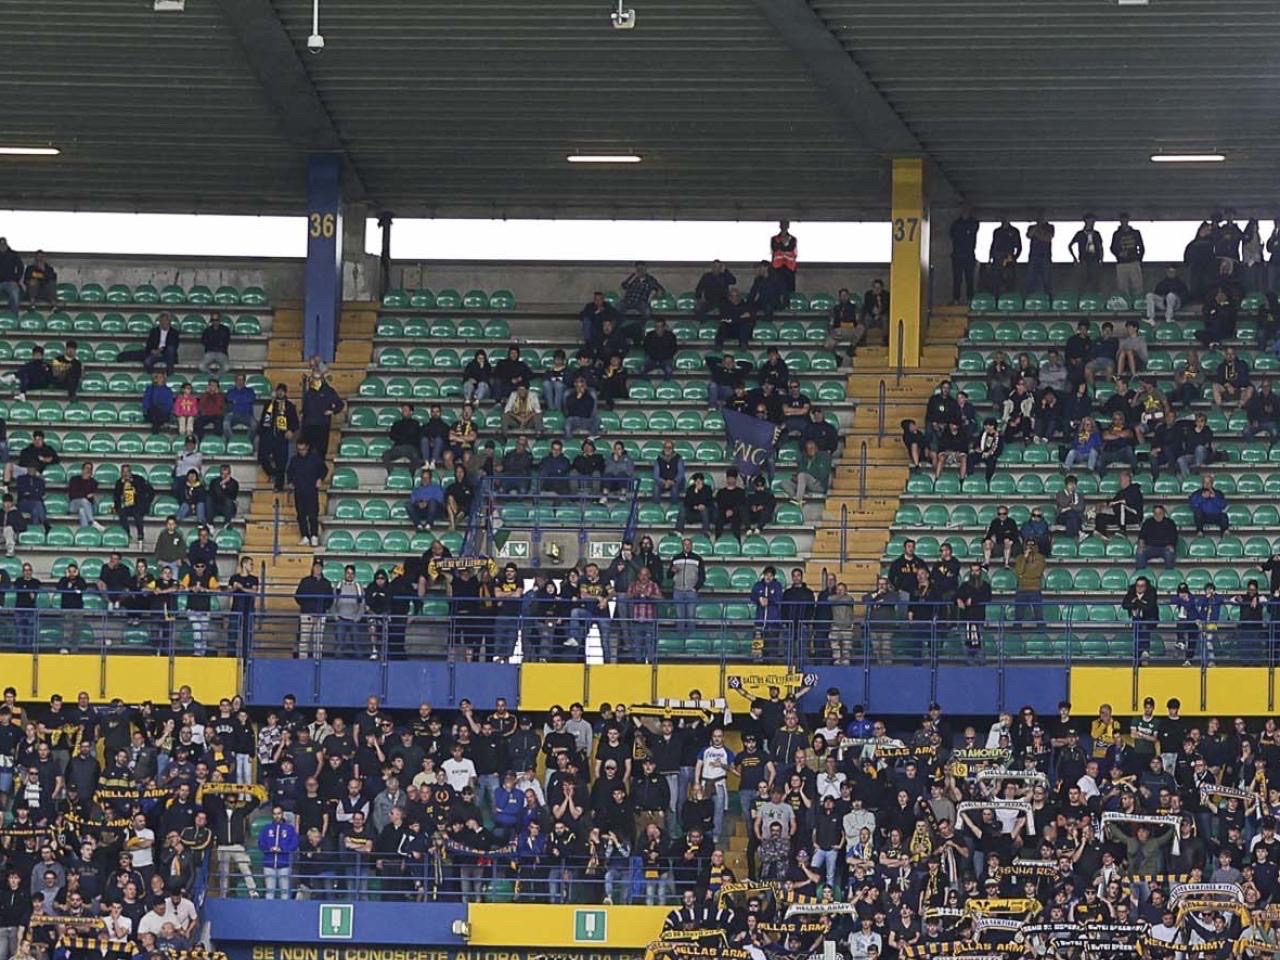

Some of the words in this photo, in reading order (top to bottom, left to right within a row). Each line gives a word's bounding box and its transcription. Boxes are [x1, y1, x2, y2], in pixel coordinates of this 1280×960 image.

[309, 212, 334, 239] 36
[893, 216, 919, 243] 37
[94, 788, 140, 798] HELLAS
[1144, 938, 1187, 950] HELLAS
[1192, 939, 1226, 950] ARMY
[252, 947, 275, 960] SE
[280, 948, 318, 960] NON
